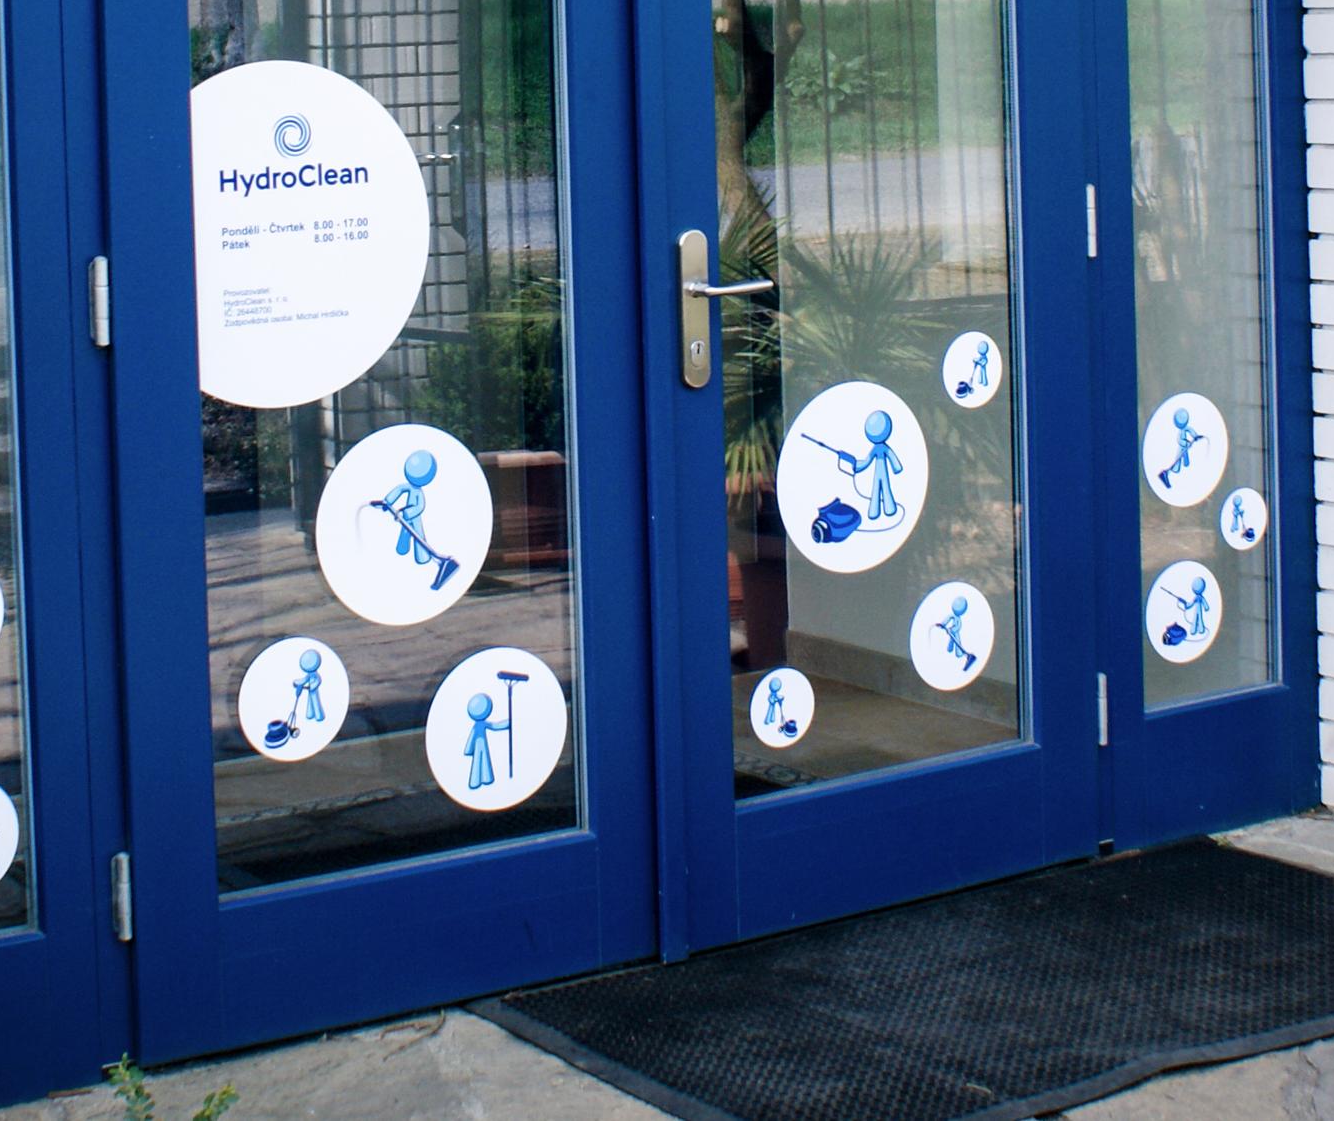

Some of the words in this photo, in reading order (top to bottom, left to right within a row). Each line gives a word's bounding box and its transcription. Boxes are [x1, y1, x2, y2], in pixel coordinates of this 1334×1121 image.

[219, 163, 369, 198] HydroClean
[268, 222, 305, 234] Čtvrtek
[313, 220, 334, 230] 8.00
[343, 217, 369, 228] 17.00
[221, 239, 250, 250] Pátek
[314, 233, 335, 243] 8.00
[344, 230, 369, 240] 16.00
